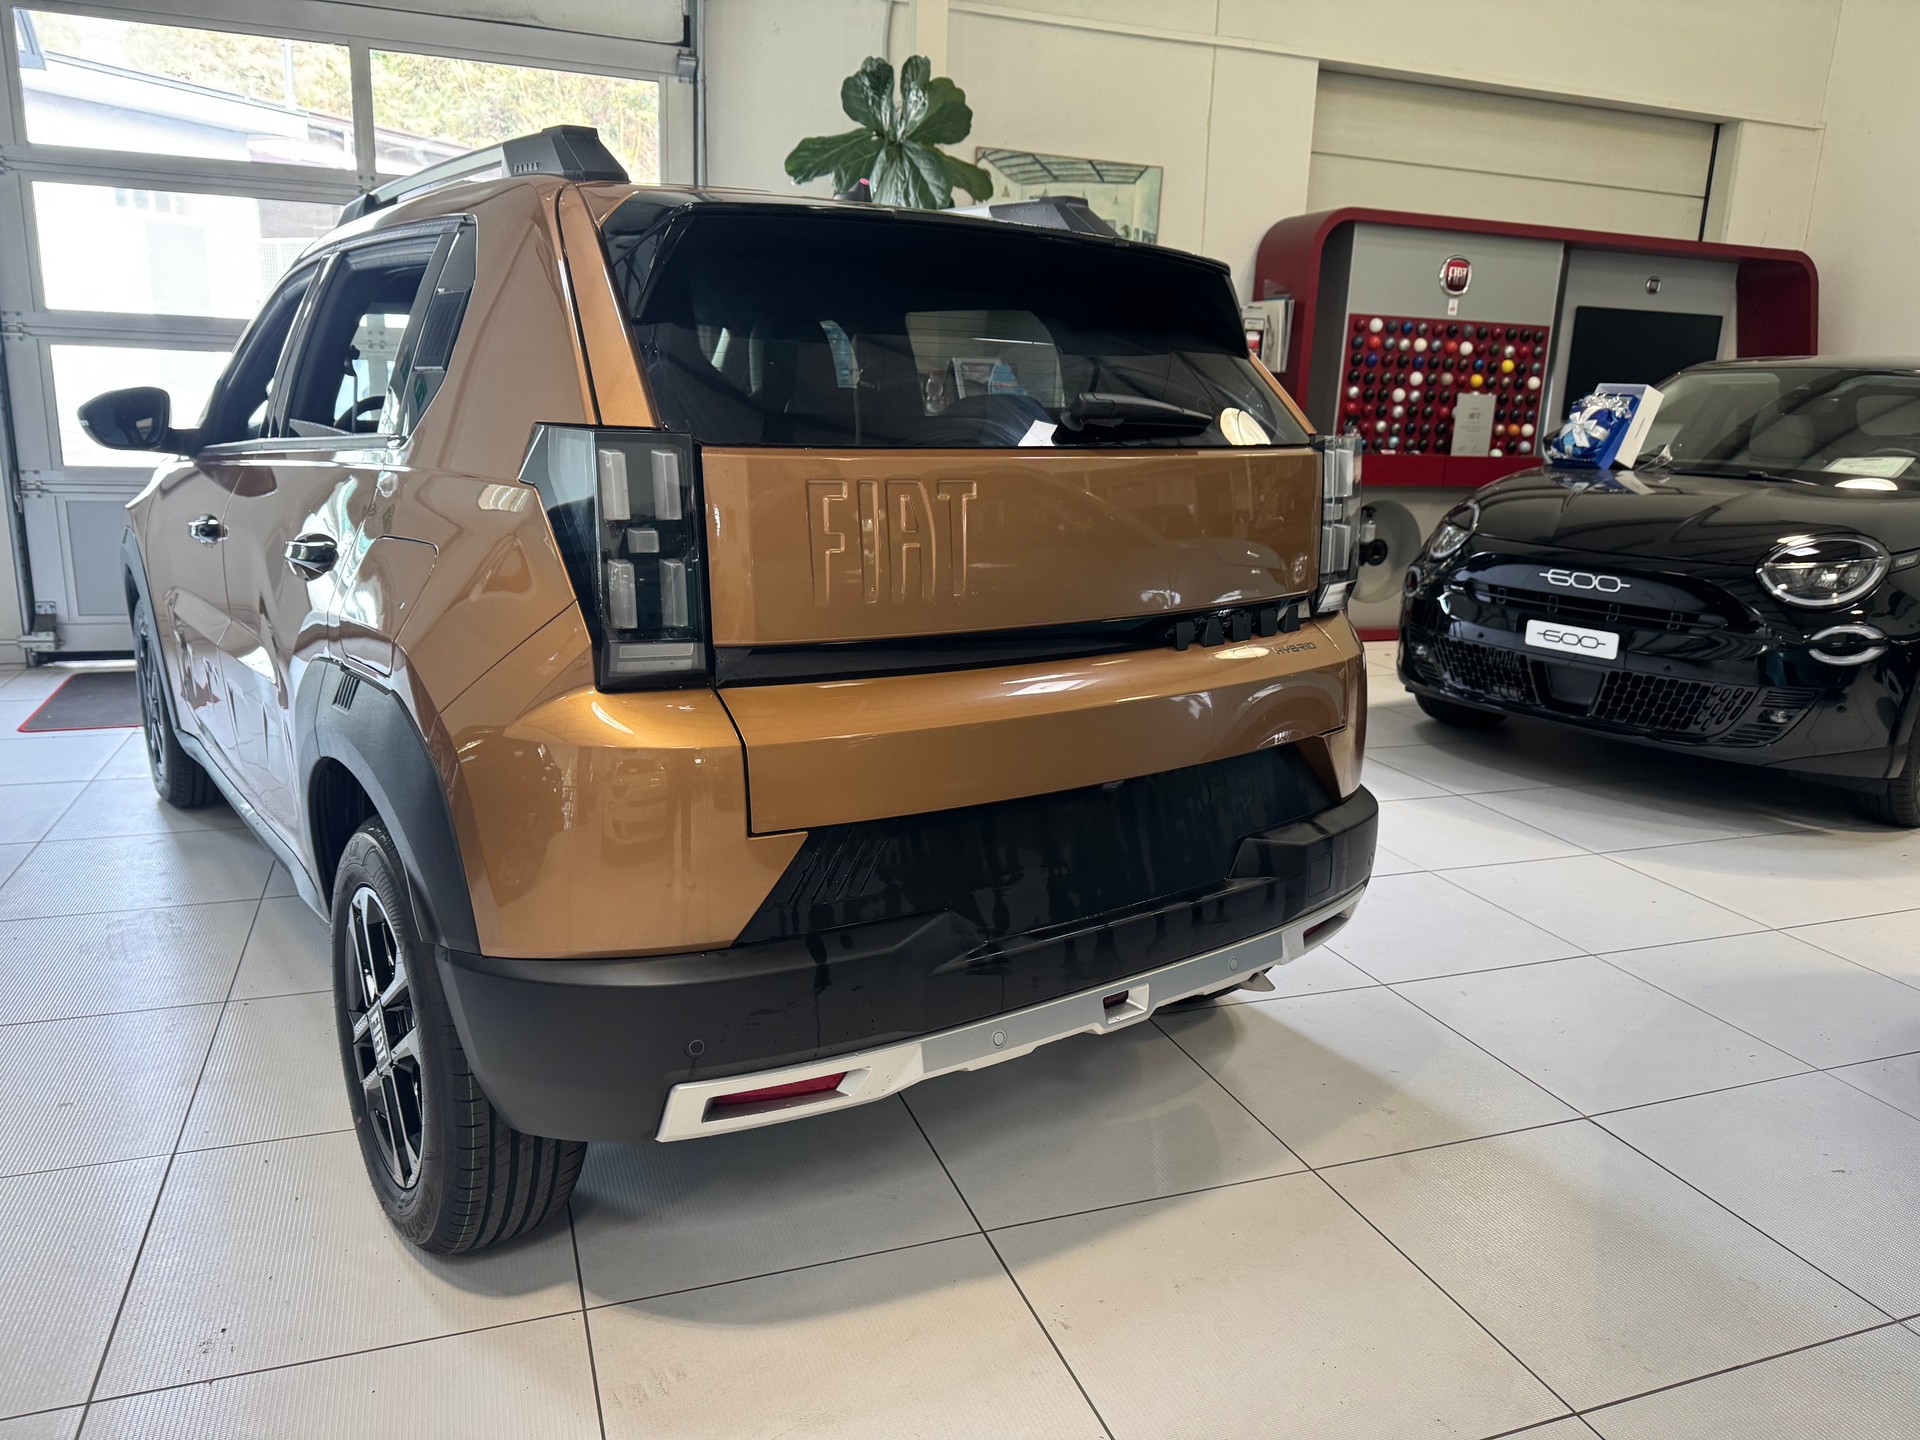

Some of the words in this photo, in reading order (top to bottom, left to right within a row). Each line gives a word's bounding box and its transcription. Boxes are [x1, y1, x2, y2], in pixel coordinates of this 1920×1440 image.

[805, 479, 977, 603] FIAT
[1543, 568, 1626, 593] 600
[1274, 642, 1317, 656] HYBRID
[1541, 629, 1602, 649] 600
[370, 1009, 390, 1062] FIAT
